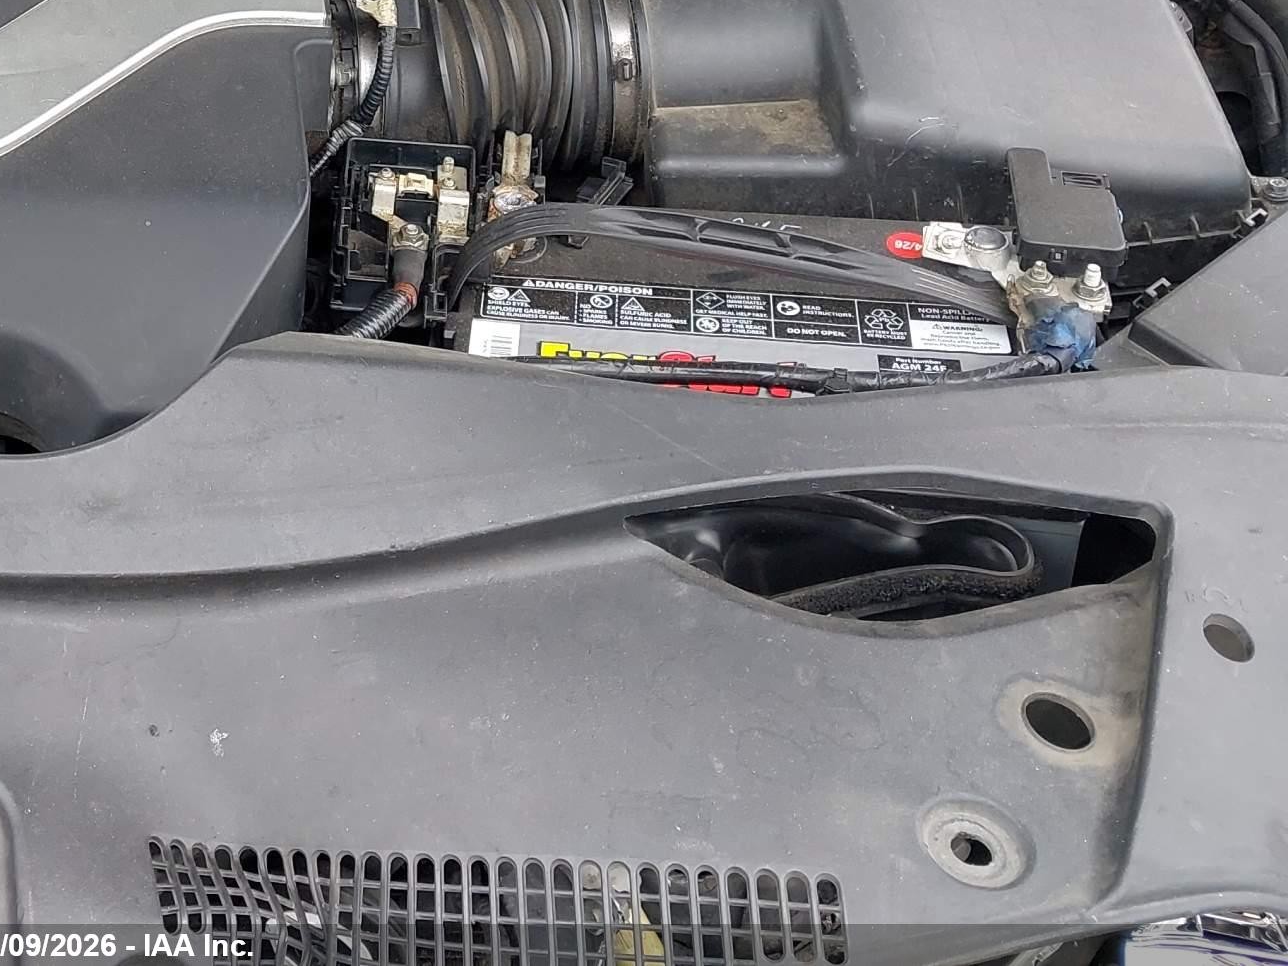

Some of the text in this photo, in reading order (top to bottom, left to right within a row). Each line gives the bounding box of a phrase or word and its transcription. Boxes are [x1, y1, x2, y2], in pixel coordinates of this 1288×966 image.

[535, 280, 653, 295] DANGER/POISON
[487, 305, 523, 313] EXPLOSIVE
[892, 362, 922, 371] AGM
